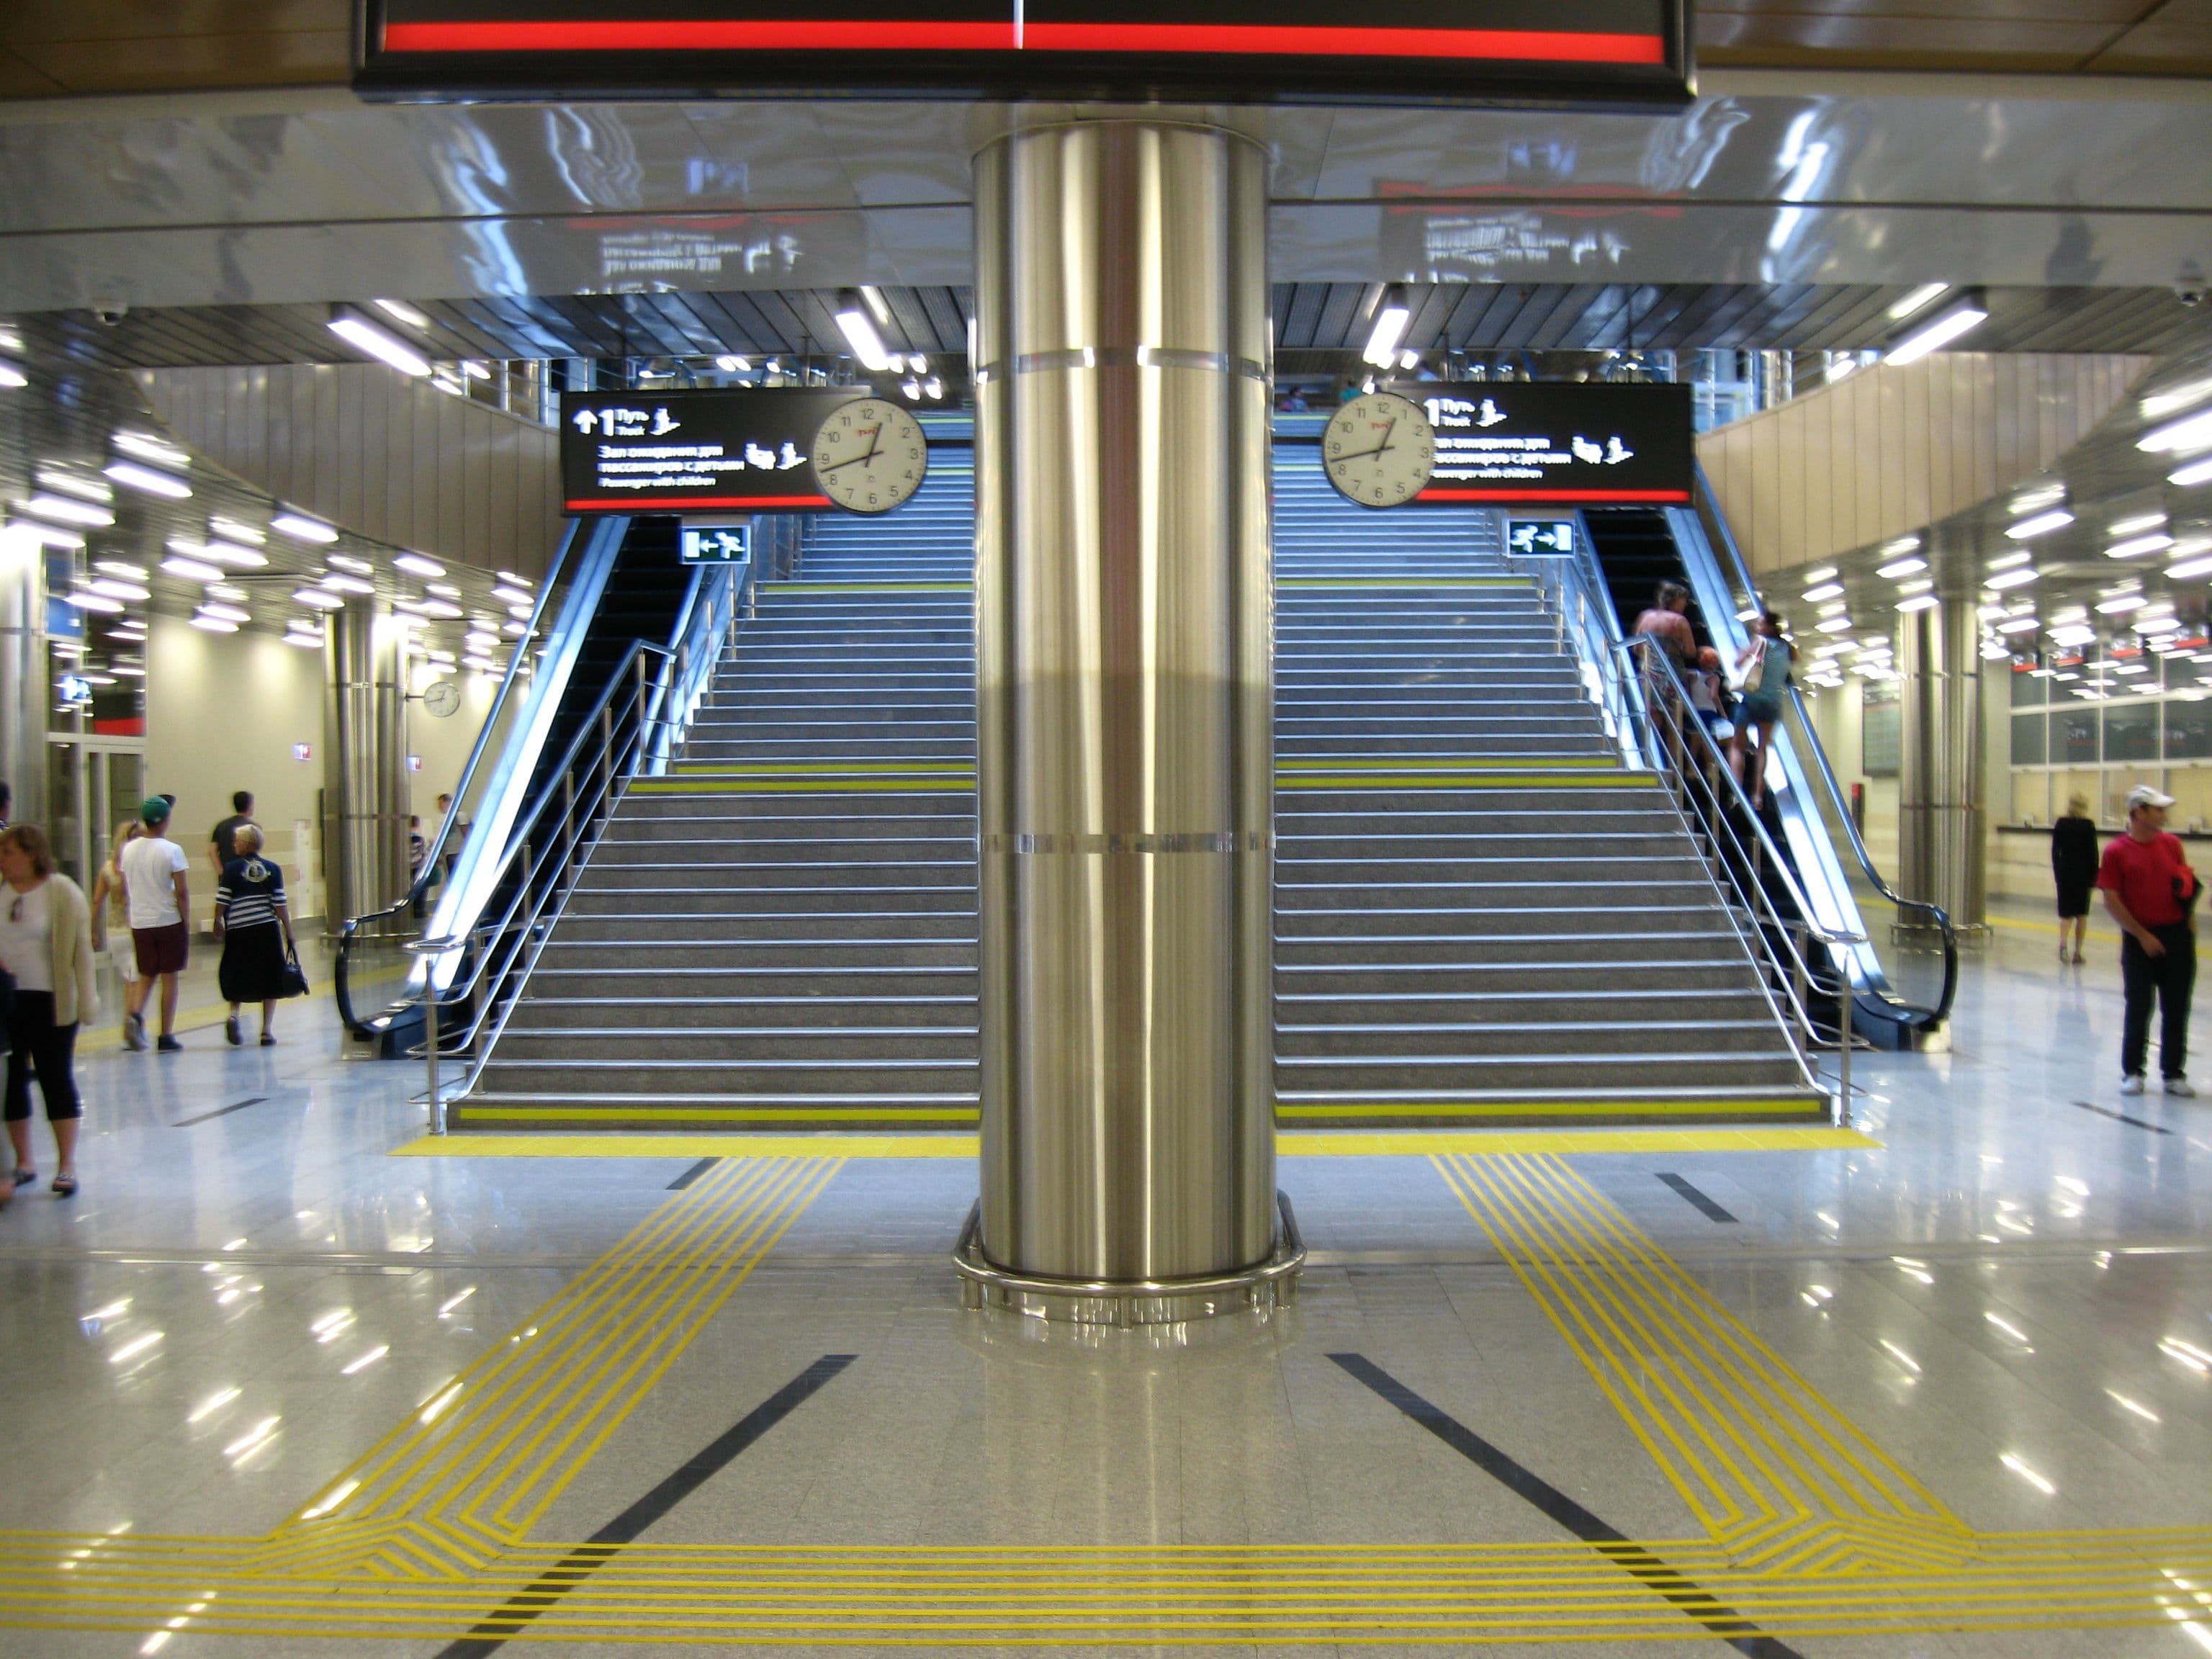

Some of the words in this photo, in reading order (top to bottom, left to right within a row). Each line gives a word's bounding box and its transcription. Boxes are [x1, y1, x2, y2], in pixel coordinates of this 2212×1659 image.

[863, 408, 874, 420] 12
[1357, 408, 1367, 419] 11
[1377, 402, 1390, 414] 12
[1424, 397, 1439, 427] 1
[1439, 398, 1475, 415] Путь
[598, 409, 613, 436] 1
[614, 408, 649, 424] Путь
[840, 415, 851, 427] 11
[886, 413, 893, 423] 1
[902, 427, 910, 439] 2
[1341, 421, 1354, 433] 10
[1413, 425, 1424, 437] 2
[827, 431, 840, 444] 10
[910, 448, 919, 460] 3
[1332, 442, 1341, 454] 9
[1421, 446, 1430, 459] 3
[821, 453, 830, 465] 9
[904, 469, 913, 480] 4
[1338, 463, 1347, 476] 8
[1412, 468, 1421, 479] 4
[829, 474, 837, 485] 8
[1352, 479, 1362, 491] 7
[846, 487, 855, 500] 7
[889, 485, 899, 498] 5
[1375, 487, 1383, 499] 6
[1396, 482, 1406, 494] 5
[868, 493, 877, 505] 6
